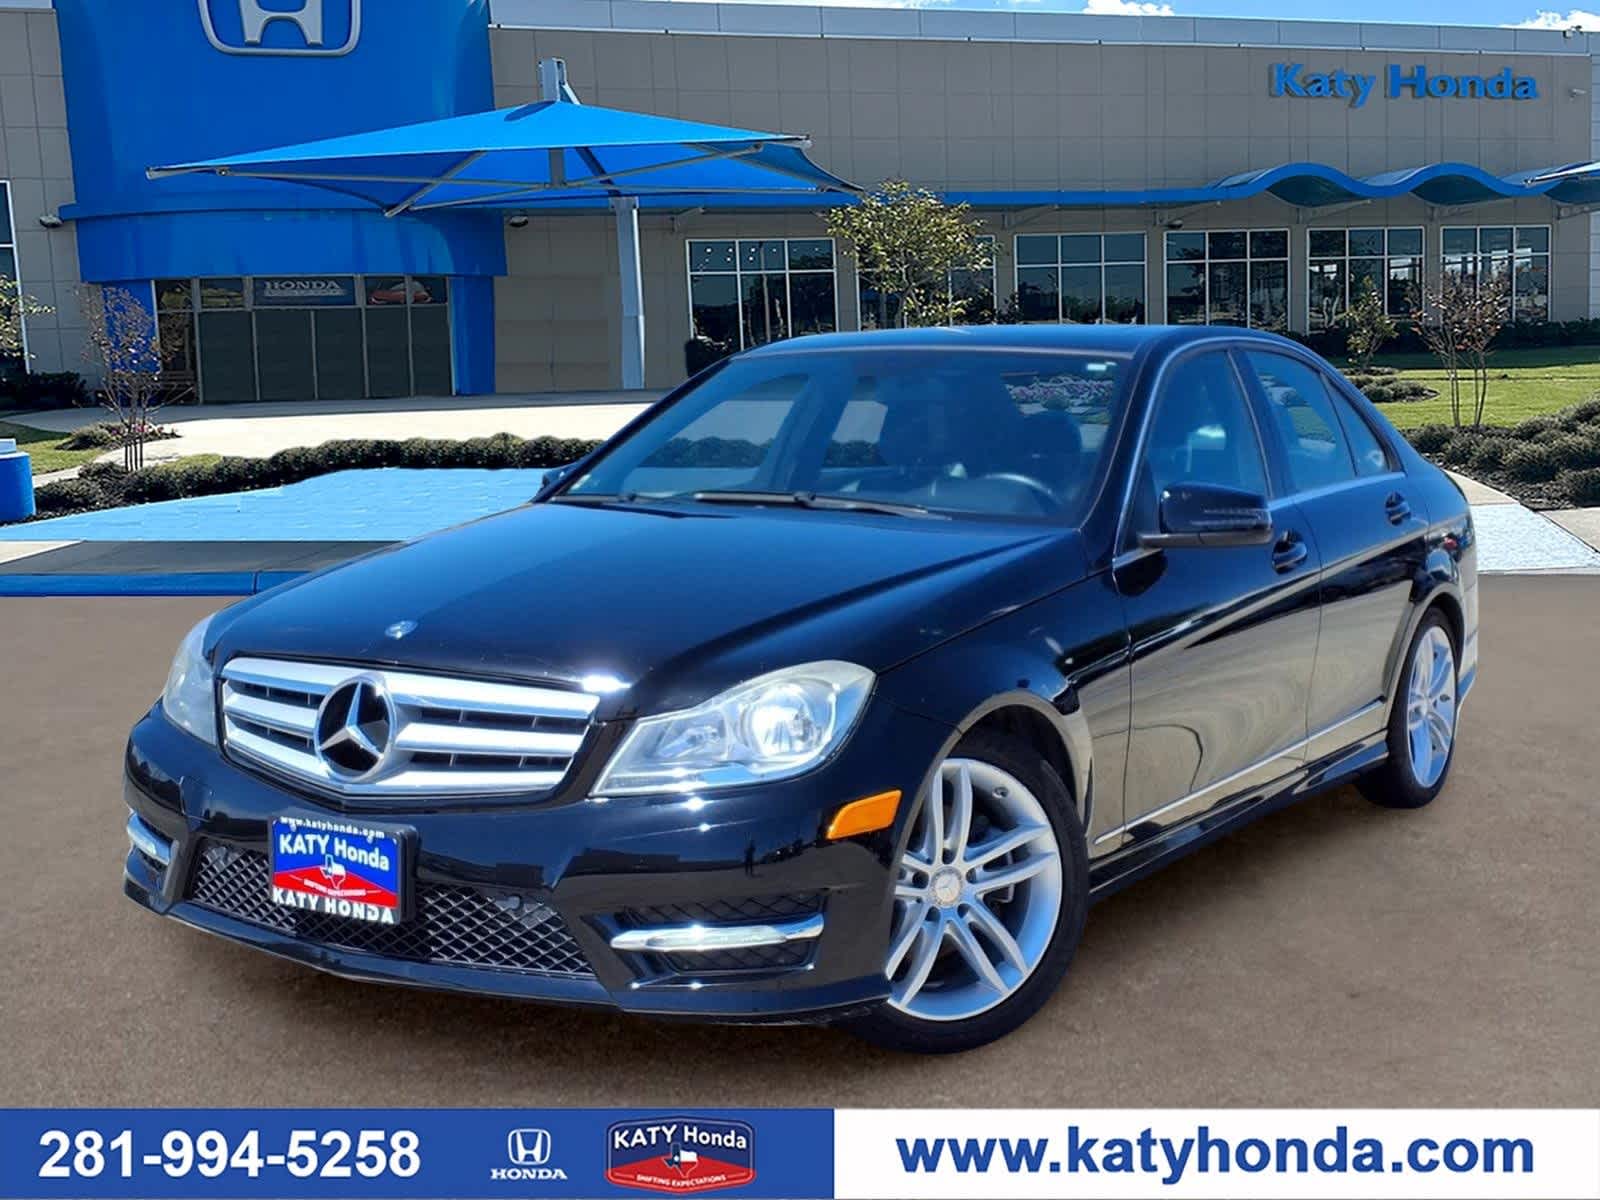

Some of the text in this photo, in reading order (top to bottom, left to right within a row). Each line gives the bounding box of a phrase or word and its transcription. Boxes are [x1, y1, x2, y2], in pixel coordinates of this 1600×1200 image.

[1271, 63, 1539, 108] Katy Honda
[264, 280, 341, 289] HONDA
[279, 833, 390, 872] KATY Honda
[272, 885, 320, 911] KATY
[324, 897, 395, 925] HONDA
